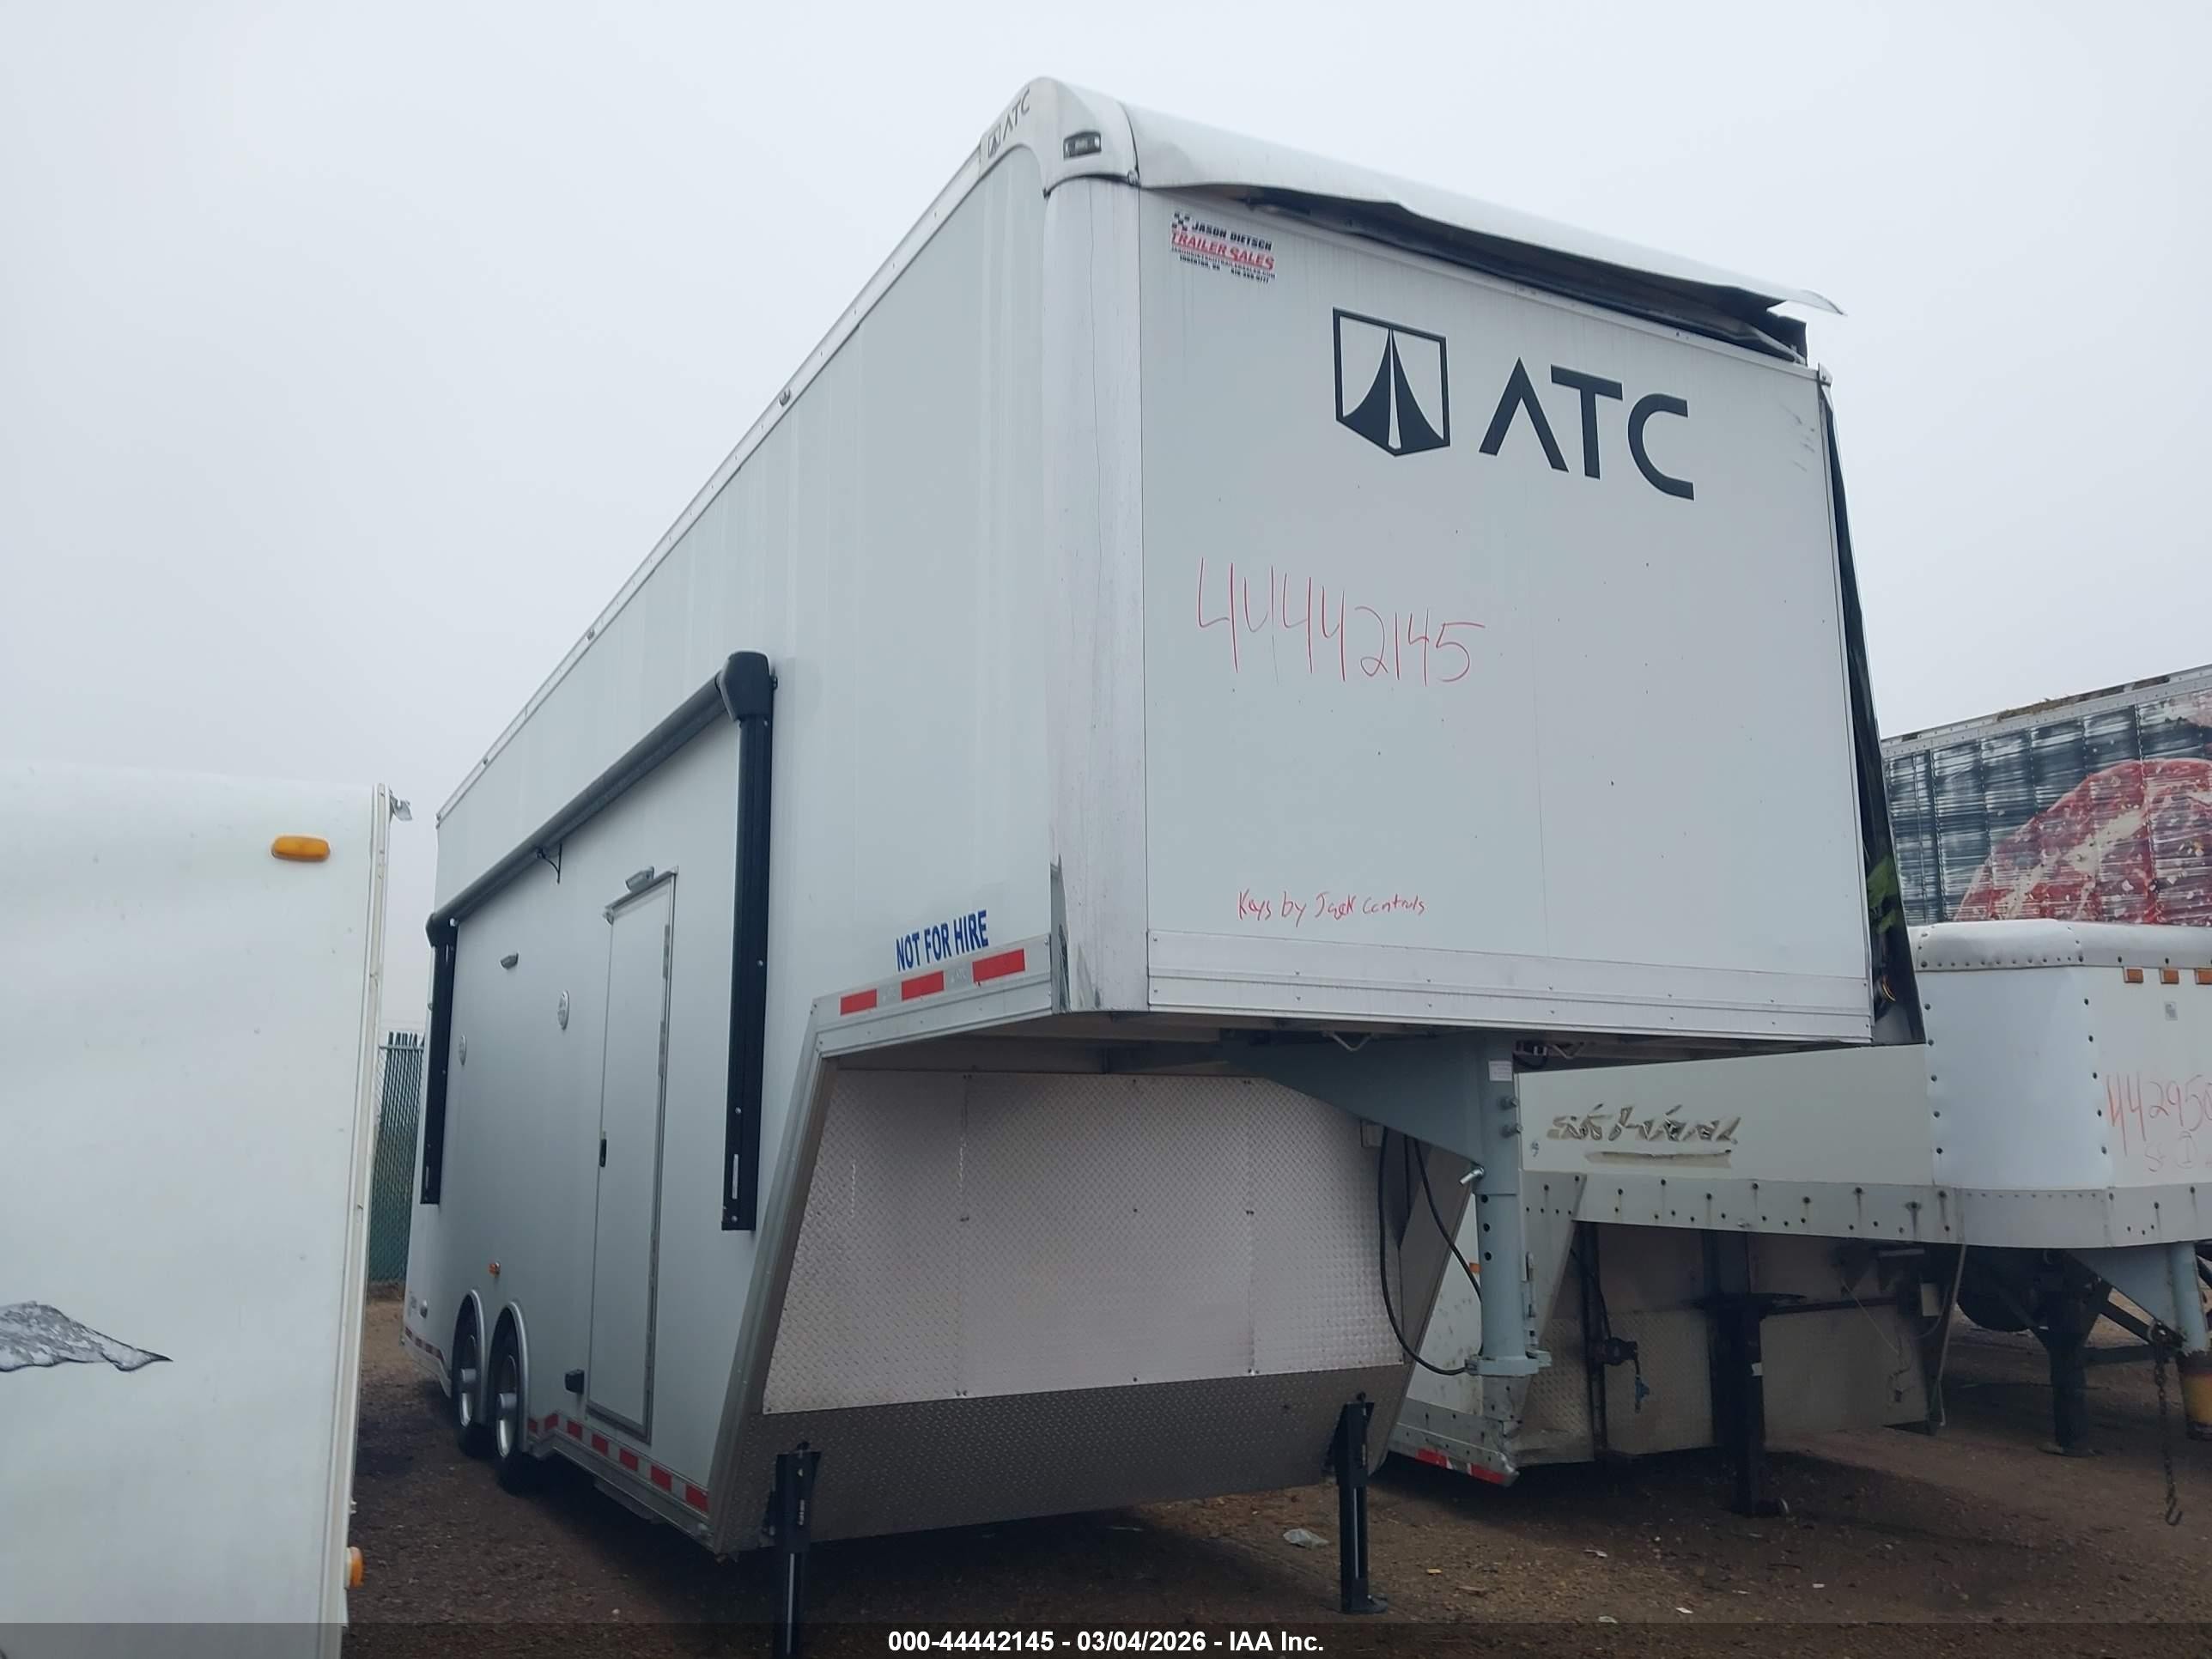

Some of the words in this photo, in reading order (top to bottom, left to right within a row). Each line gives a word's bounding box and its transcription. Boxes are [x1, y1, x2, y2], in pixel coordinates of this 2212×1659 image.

[1002, 88, 1030, 142] ATC
[1171, 232, 1228, 255] TRAILER
[1230, 248, 1275, 270] SALES
[1192, 221, 1227, 238] JASON
[1231, 233, 1273, 251] DIETSCH
[1478, 356, 1695, 501] ATC
[1196, 556, 1486, 687] 44442145
[1237, 888, 1273, 921] Keys
[1281, 890, 1307, 927] by
[896, 931, 921, 972] NOT
[923, 922, 952, 964] FOR
[953, 908, 989, 956] HIRE
